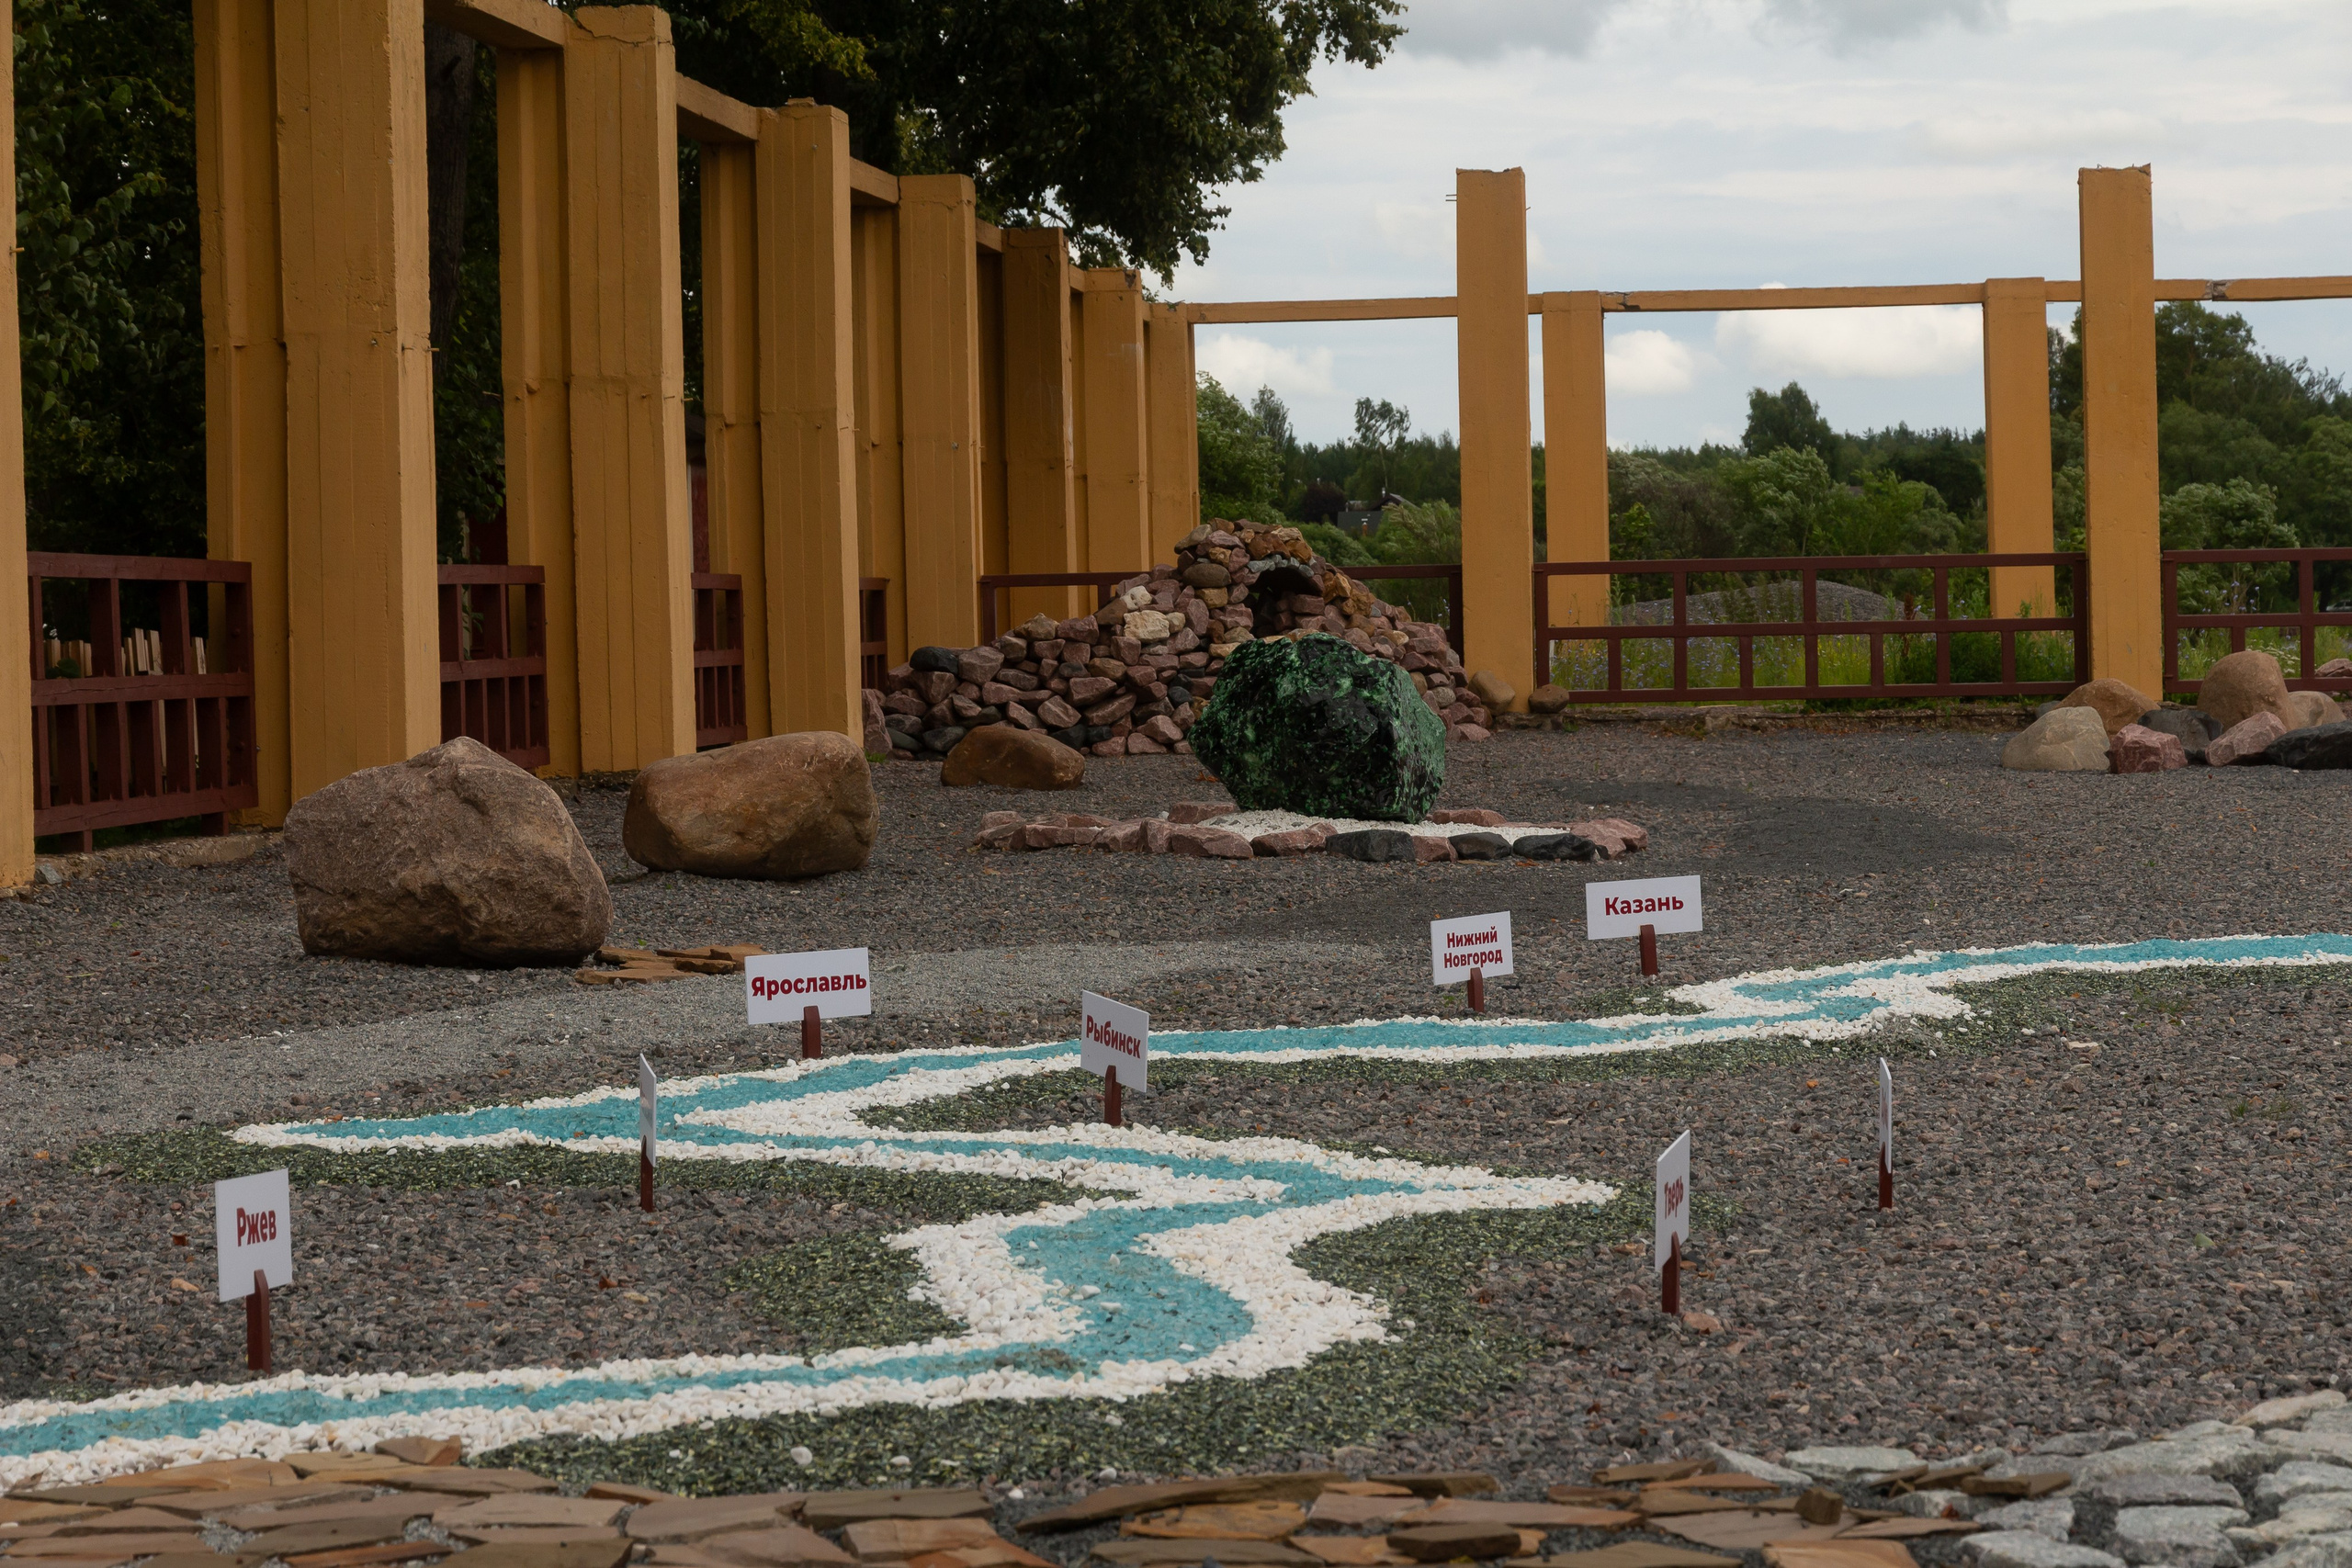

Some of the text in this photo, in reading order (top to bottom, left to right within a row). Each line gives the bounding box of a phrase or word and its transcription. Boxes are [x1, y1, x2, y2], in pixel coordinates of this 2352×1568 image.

[1605, 897, 1684, 916] Казань
[1446, 926, 1498, 948] Нижний
[1444, 949, 1503, 968] Новгород
[752, 974, 866, 1000] Ярославль
[1086, 1014, 1141, 1059] Рыбинск
[1664, 1176, 1683, 1220] Тверь
[236, 1207, 277, 1247] Ржев
